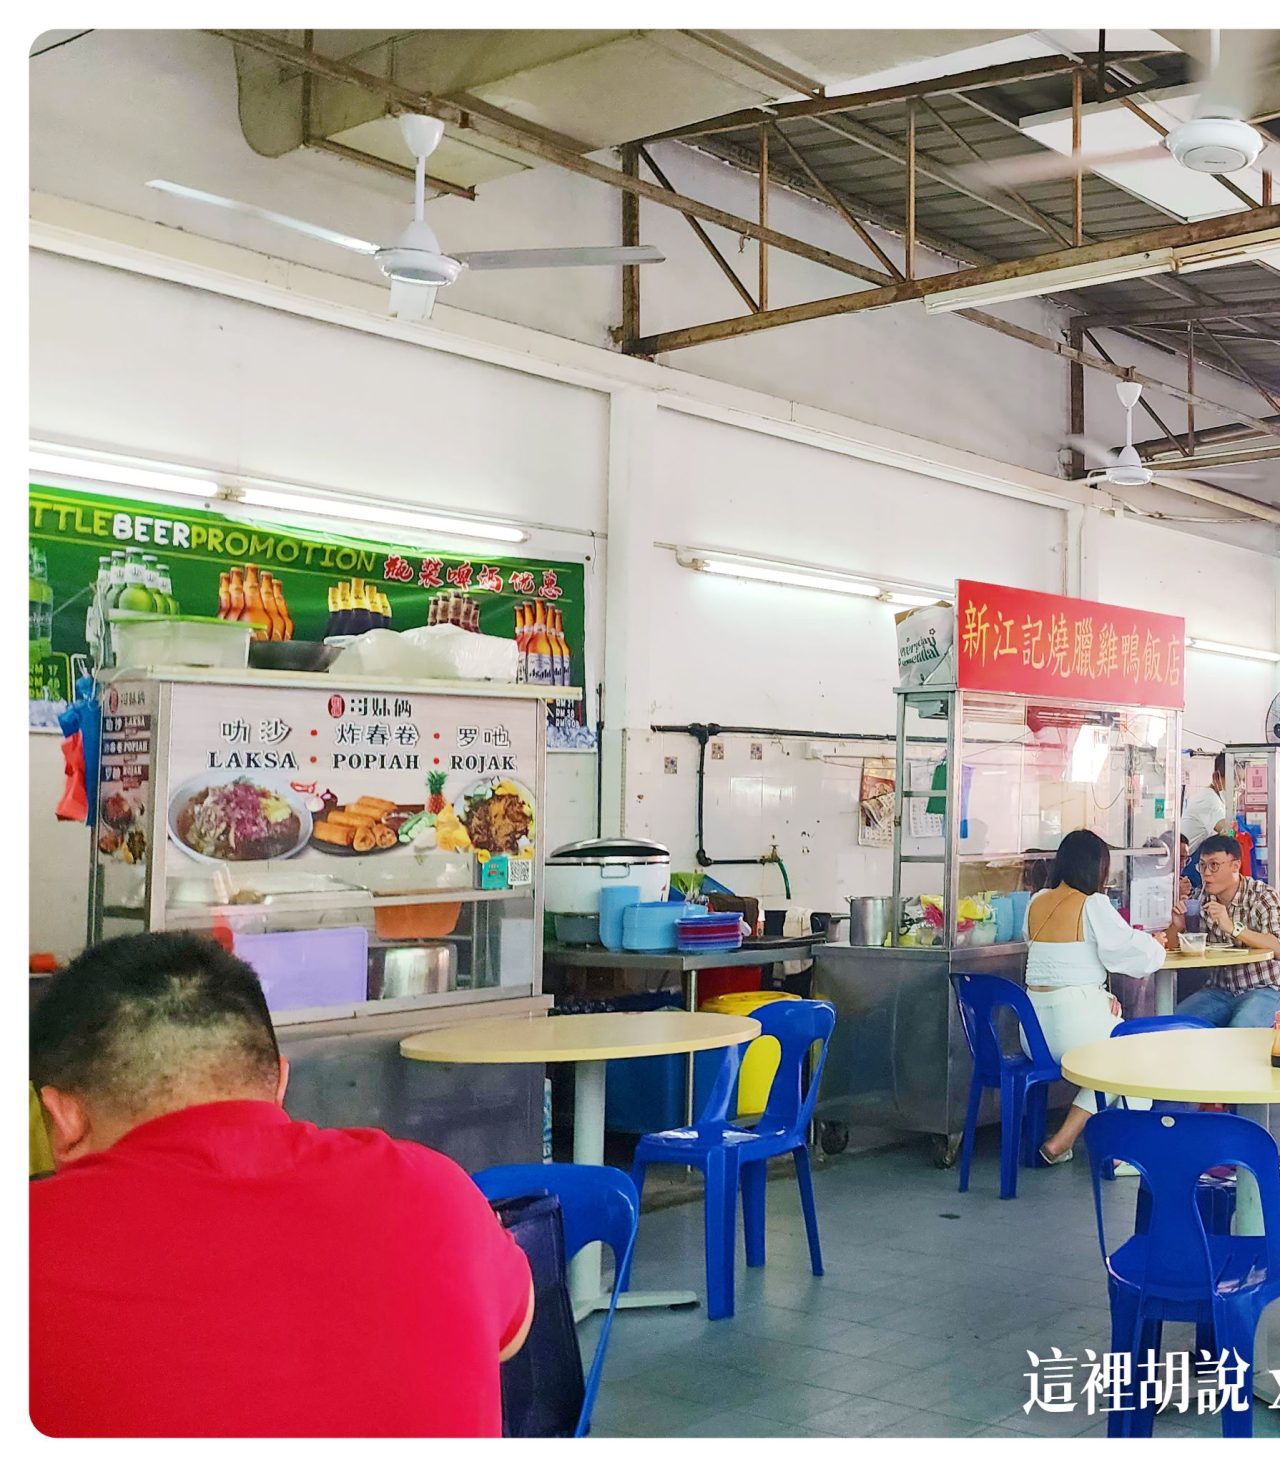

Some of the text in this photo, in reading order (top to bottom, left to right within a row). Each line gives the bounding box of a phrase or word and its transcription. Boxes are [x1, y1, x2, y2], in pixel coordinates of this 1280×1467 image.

[336, 723, 419, 746] 炸春卷
[208, 751, 516, 774] LAKSA POPIAH ROJAK
